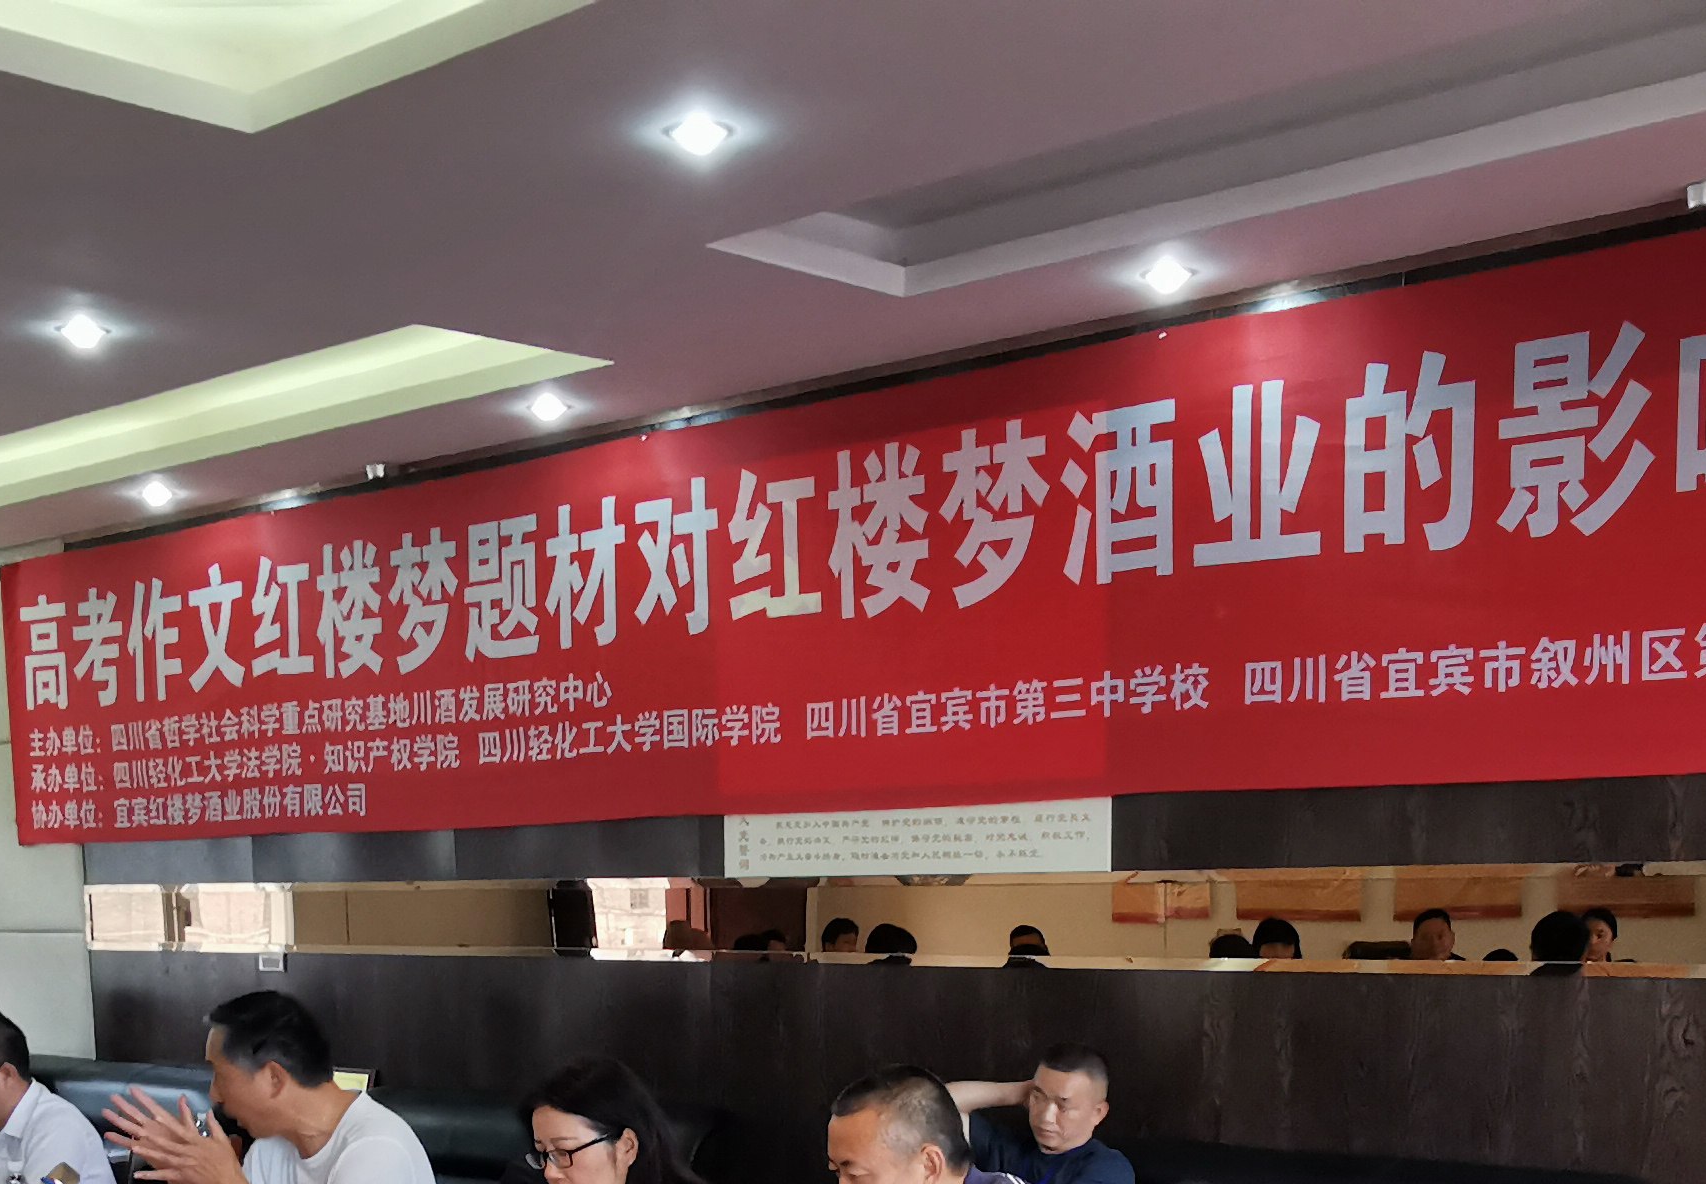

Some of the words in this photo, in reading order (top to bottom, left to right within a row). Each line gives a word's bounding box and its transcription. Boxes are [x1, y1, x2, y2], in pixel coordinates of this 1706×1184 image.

[478, 703, 781, 765] 四川轻化工大学国际学院
[805, 660, 1210, 741] 四川省宜宾市第三中学校
